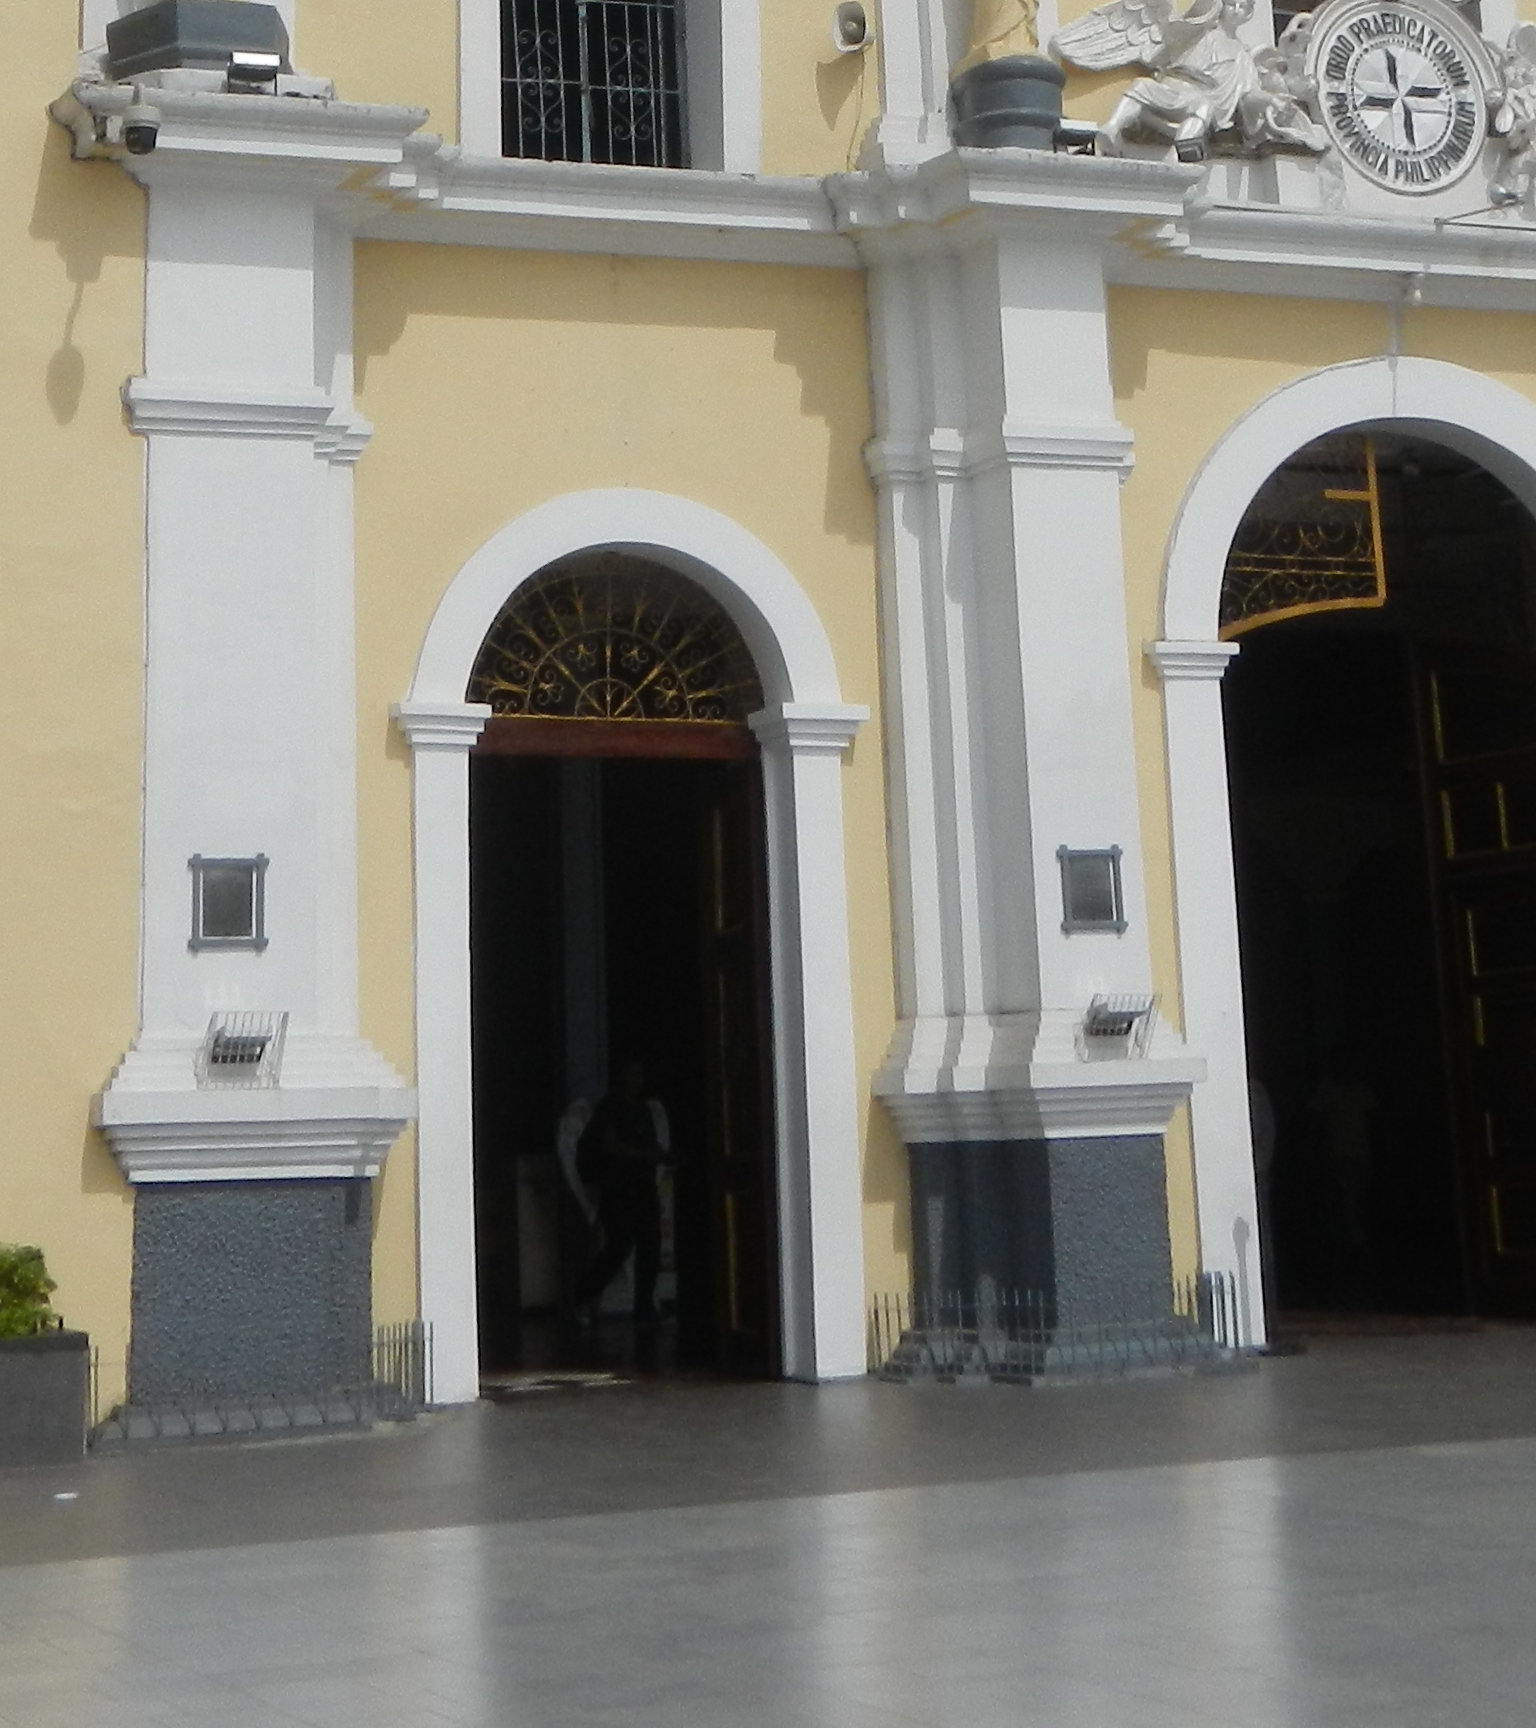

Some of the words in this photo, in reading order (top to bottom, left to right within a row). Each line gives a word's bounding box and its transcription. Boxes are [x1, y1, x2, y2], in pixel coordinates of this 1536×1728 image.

[1325, 34, 1355, 81] ORDO
[1348, 12, 1470, 88] PRAEDICATORUM
[1326, 90, 1389, 176] PROVINCIA
[1394, 100, 1476, 184] PHILIPPINARUM
